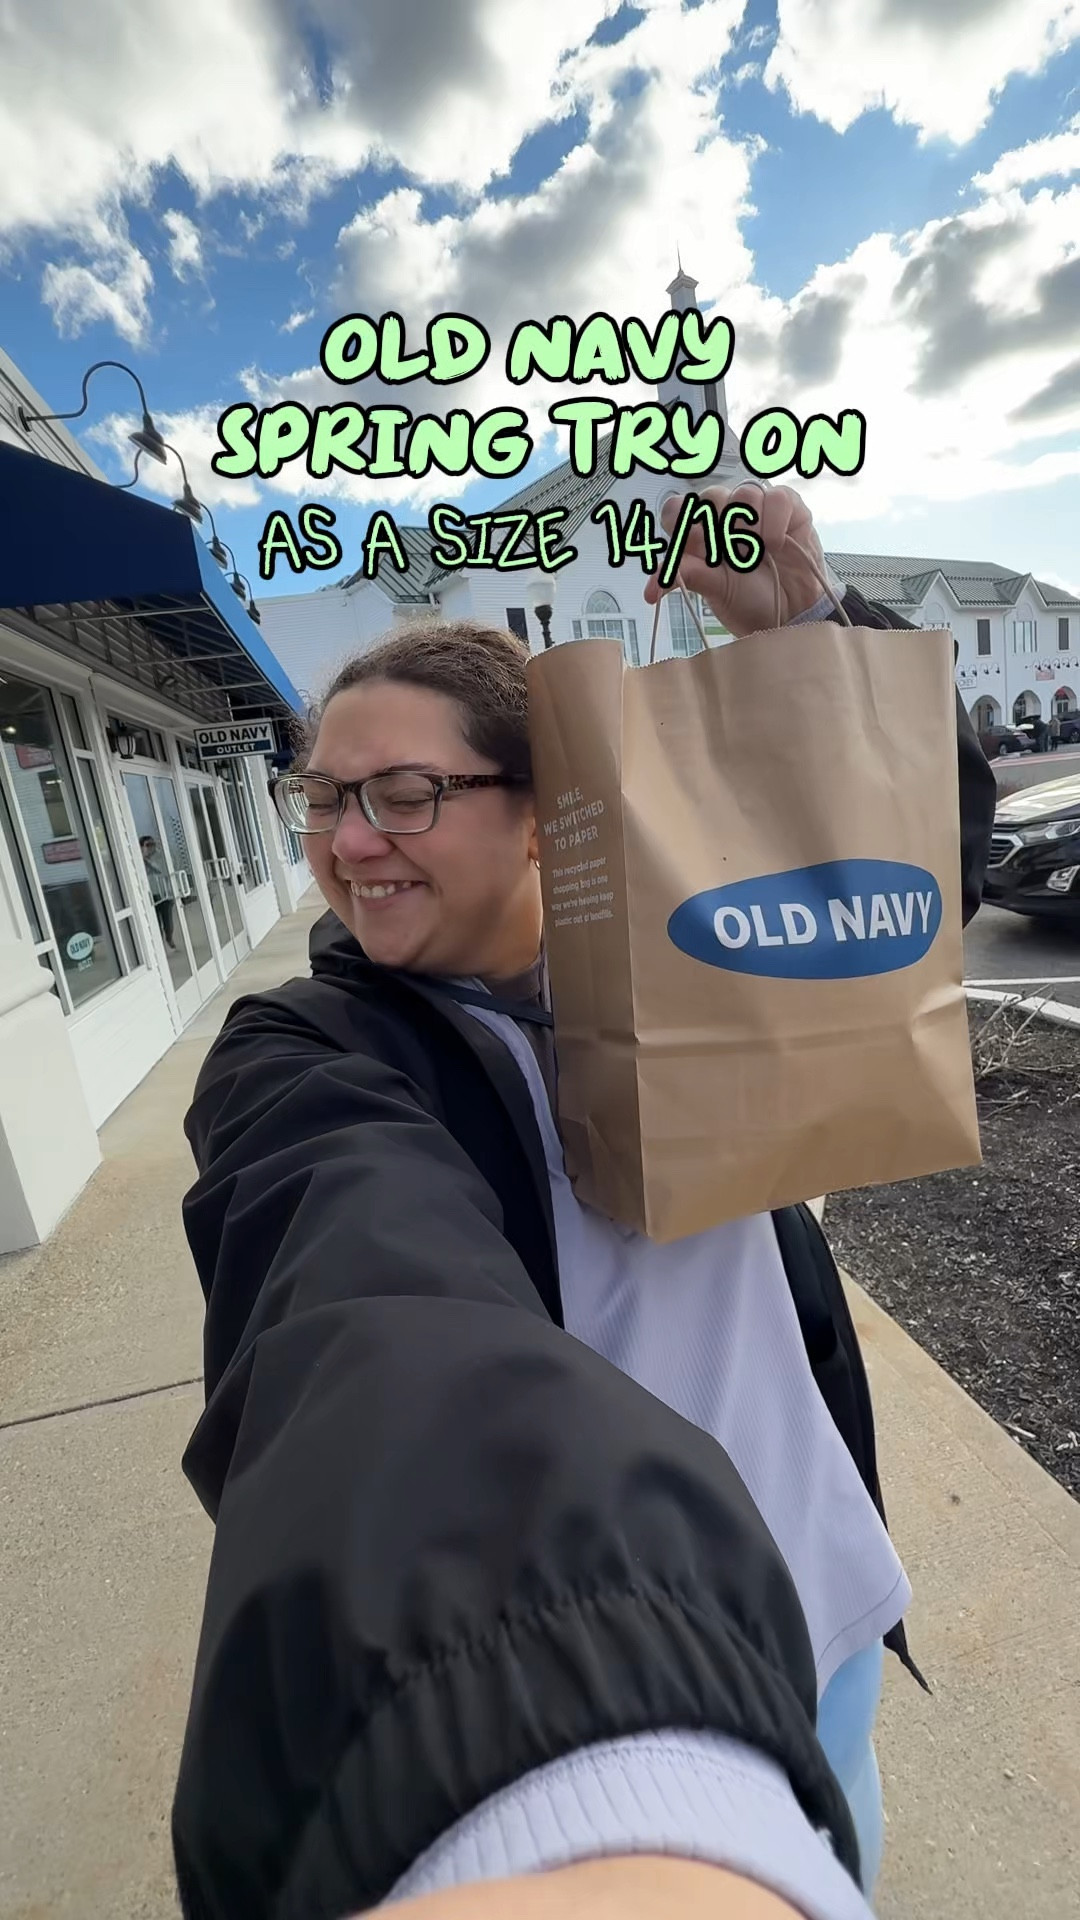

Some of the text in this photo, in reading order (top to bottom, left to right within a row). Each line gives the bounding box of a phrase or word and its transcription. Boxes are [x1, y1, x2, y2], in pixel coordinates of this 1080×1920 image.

[199, 726, 268, 744] OLD NAVY
[217, 744, 255, 754] OUTLET
[544, 800, 605, 837] WE SWITCHED
[554, 825, 598, 851] TO PAPER
[713, 891, 933, 949] OLD NAVY
